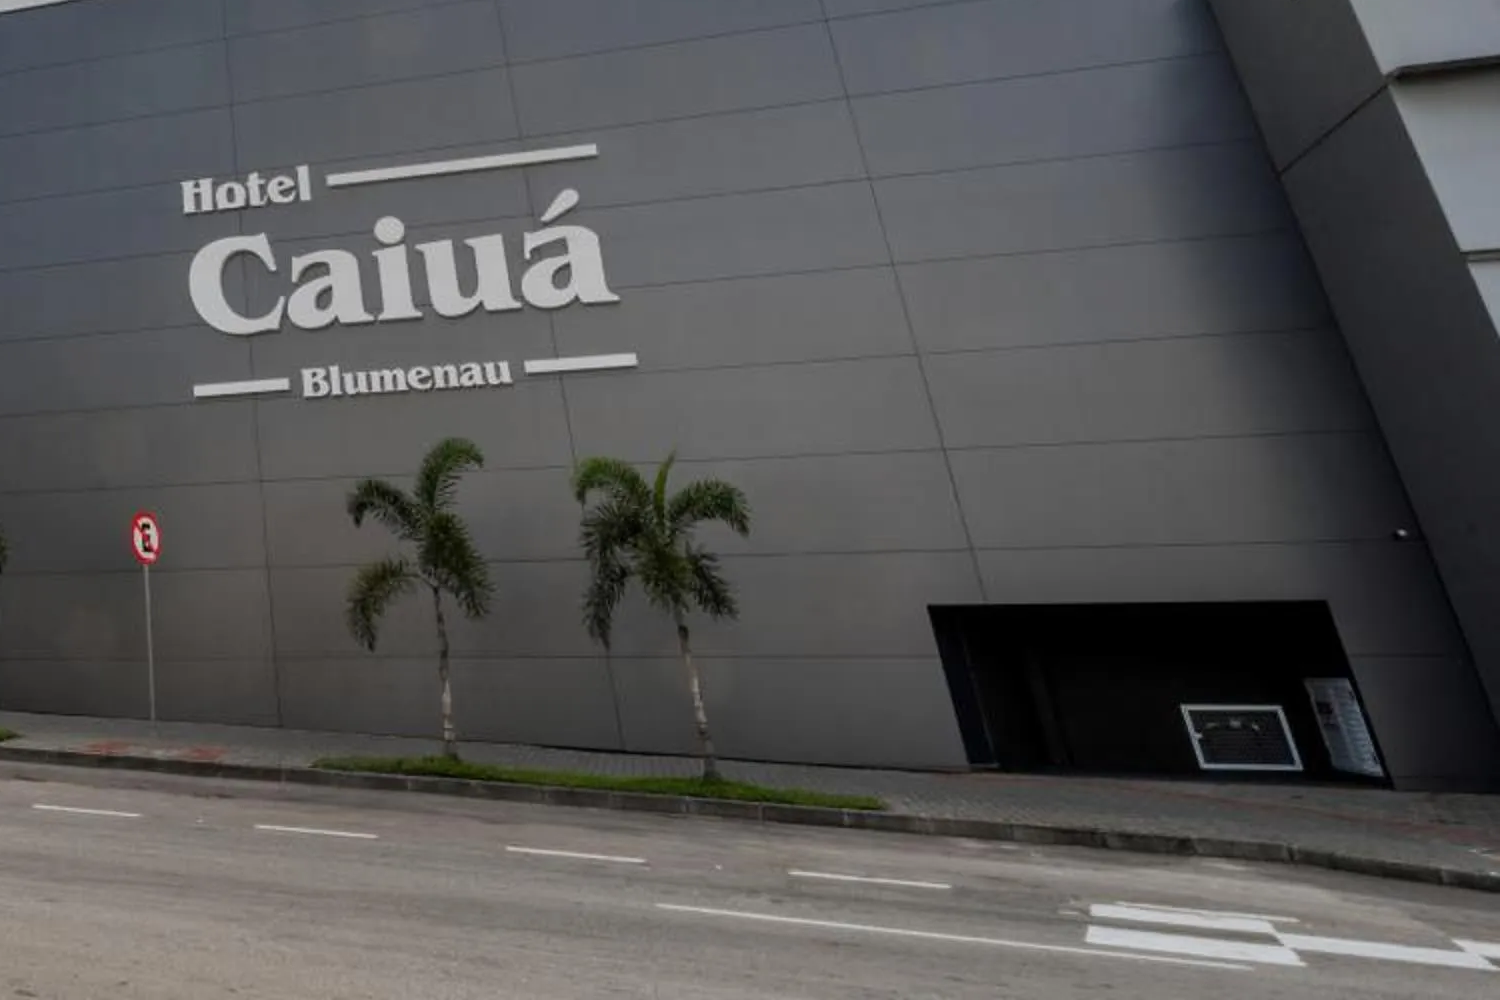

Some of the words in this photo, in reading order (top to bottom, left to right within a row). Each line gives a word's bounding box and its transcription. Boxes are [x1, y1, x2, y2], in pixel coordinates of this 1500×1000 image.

[181, 165, 313, 214] Hotel
[189, 188, 621, 336] Caiuá
[301, 359, 513, 398] Blumenau
